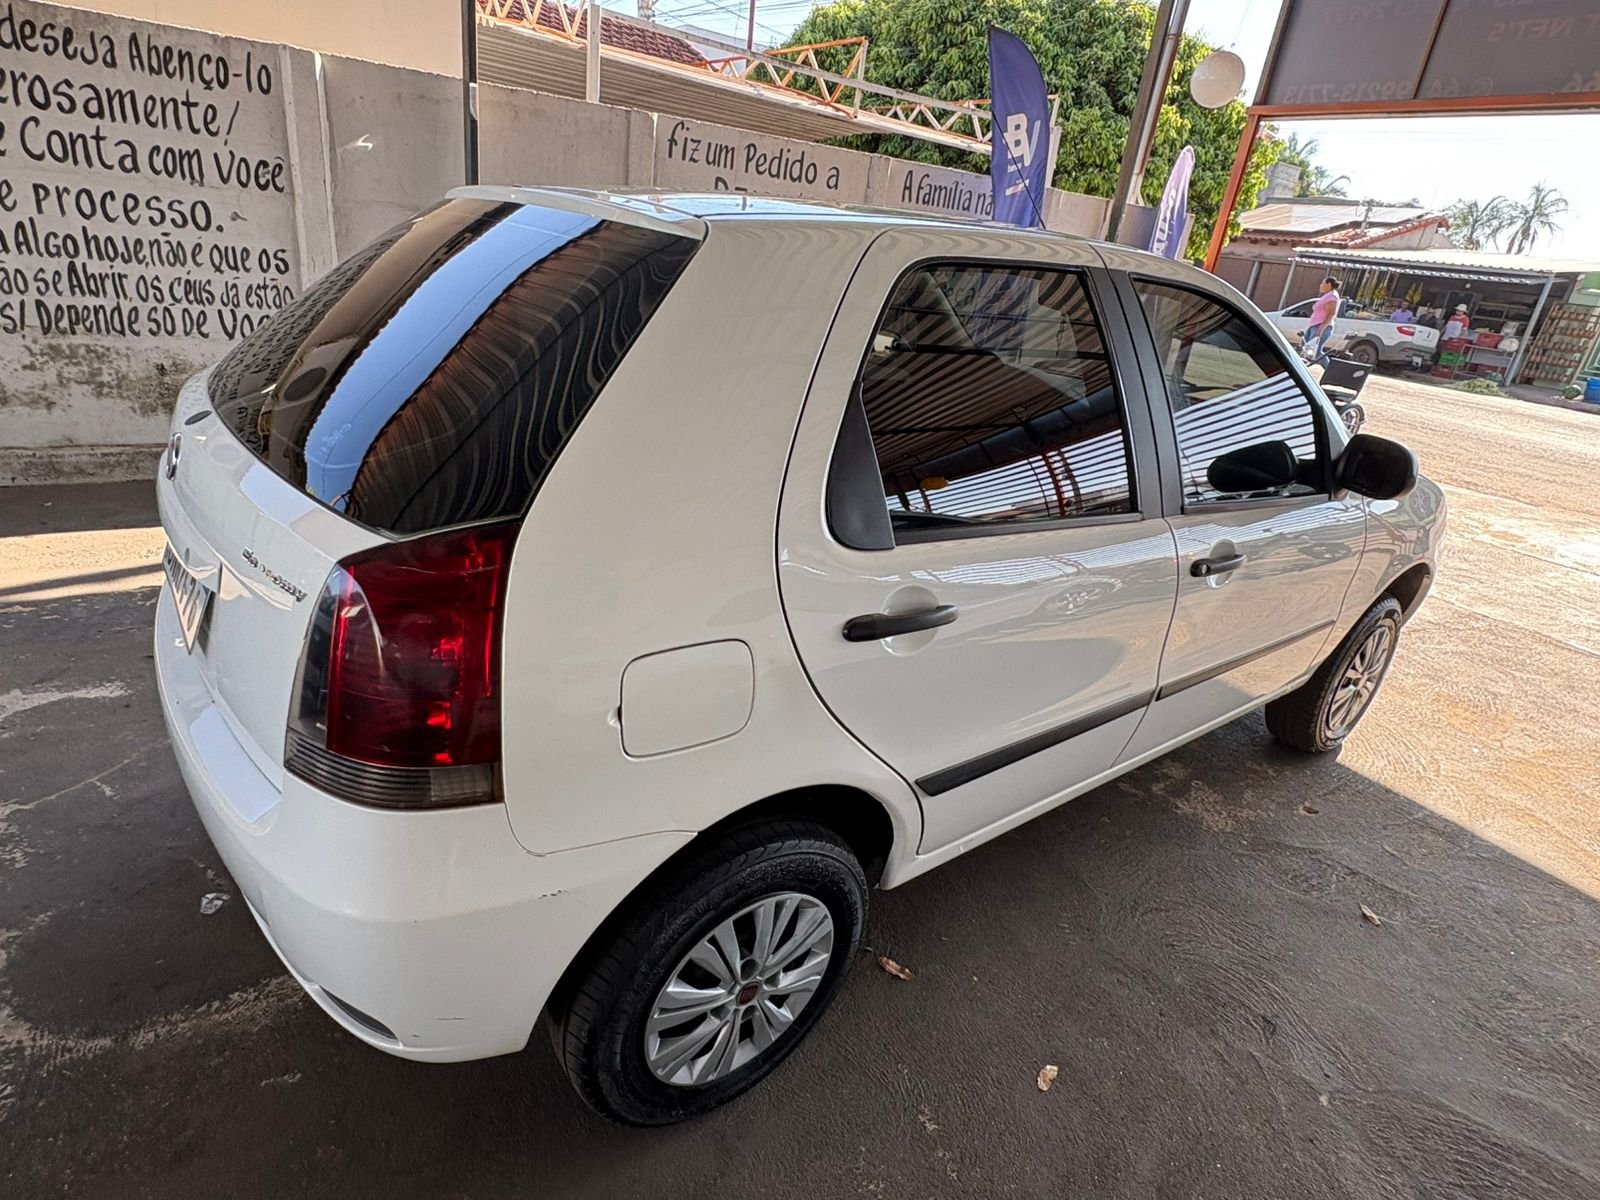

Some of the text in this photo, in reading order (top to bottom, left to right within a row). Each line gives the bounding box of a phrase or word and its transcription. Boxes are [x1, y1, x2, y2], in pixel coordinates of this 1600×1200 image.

[1003, 112, 1041, 167] BV
[148, 144, 204, 184] com
[705, 141, 736, 171] um
[744, 143, 818, 184] Pedido
[826, 166, 840, 190] a
[901, 169, 914, 203] A
[258, 248, 290, 275] os
[33, 267, 63, 297] se
[136, 274, 165, 304] os
